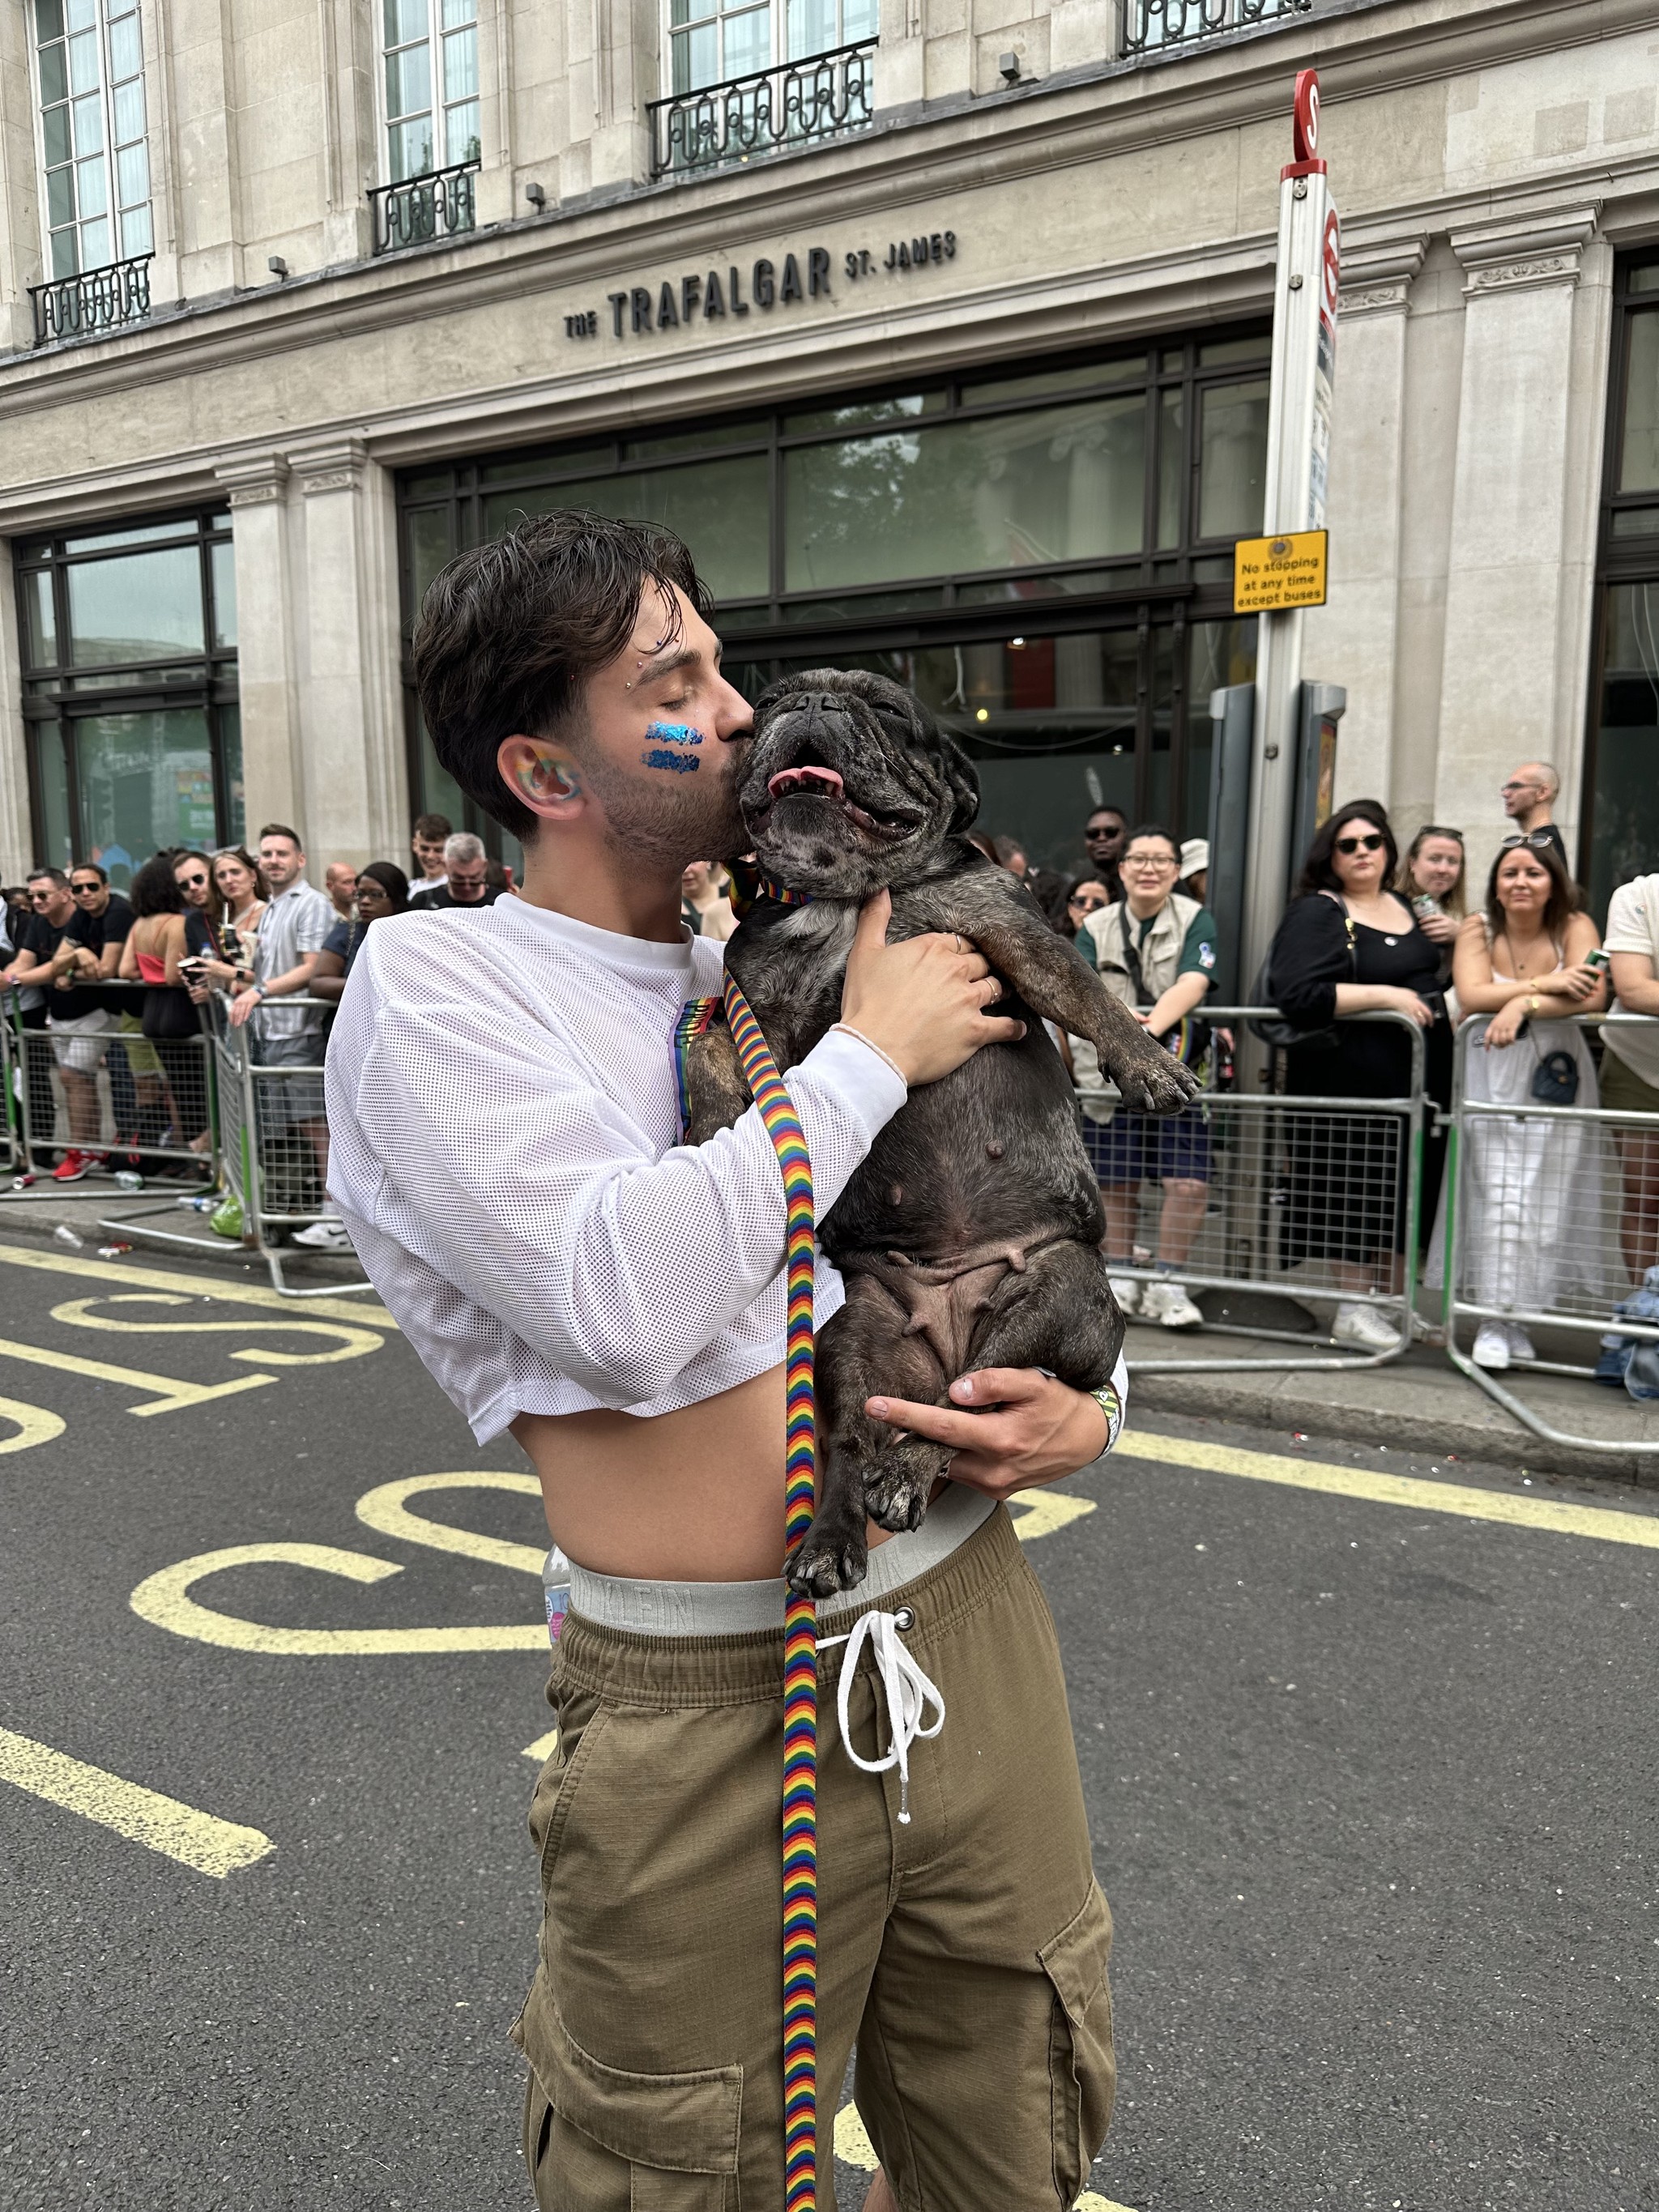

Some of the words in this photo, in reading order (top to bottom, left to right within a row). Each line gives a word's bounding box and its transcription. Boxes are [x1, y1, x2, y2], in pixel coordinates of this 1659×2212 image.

[564, 309, 598, 339] THE
[608, 246, 831, 339] TRAFALGAR
[845, 249, 876, 279] ST.
[884, 230, 957, 271] JAMES
[1242, 565, 1260, 574] No
[1264, 557, 1319, 572] stopping
[1244, 582, 1256, 591] at
[1261, 580, 1282, 590] any
[1287, 576, 1315, 586] time
[1238, 594, 1280, 607] except
[1284, 590, 1320, 602] buses
